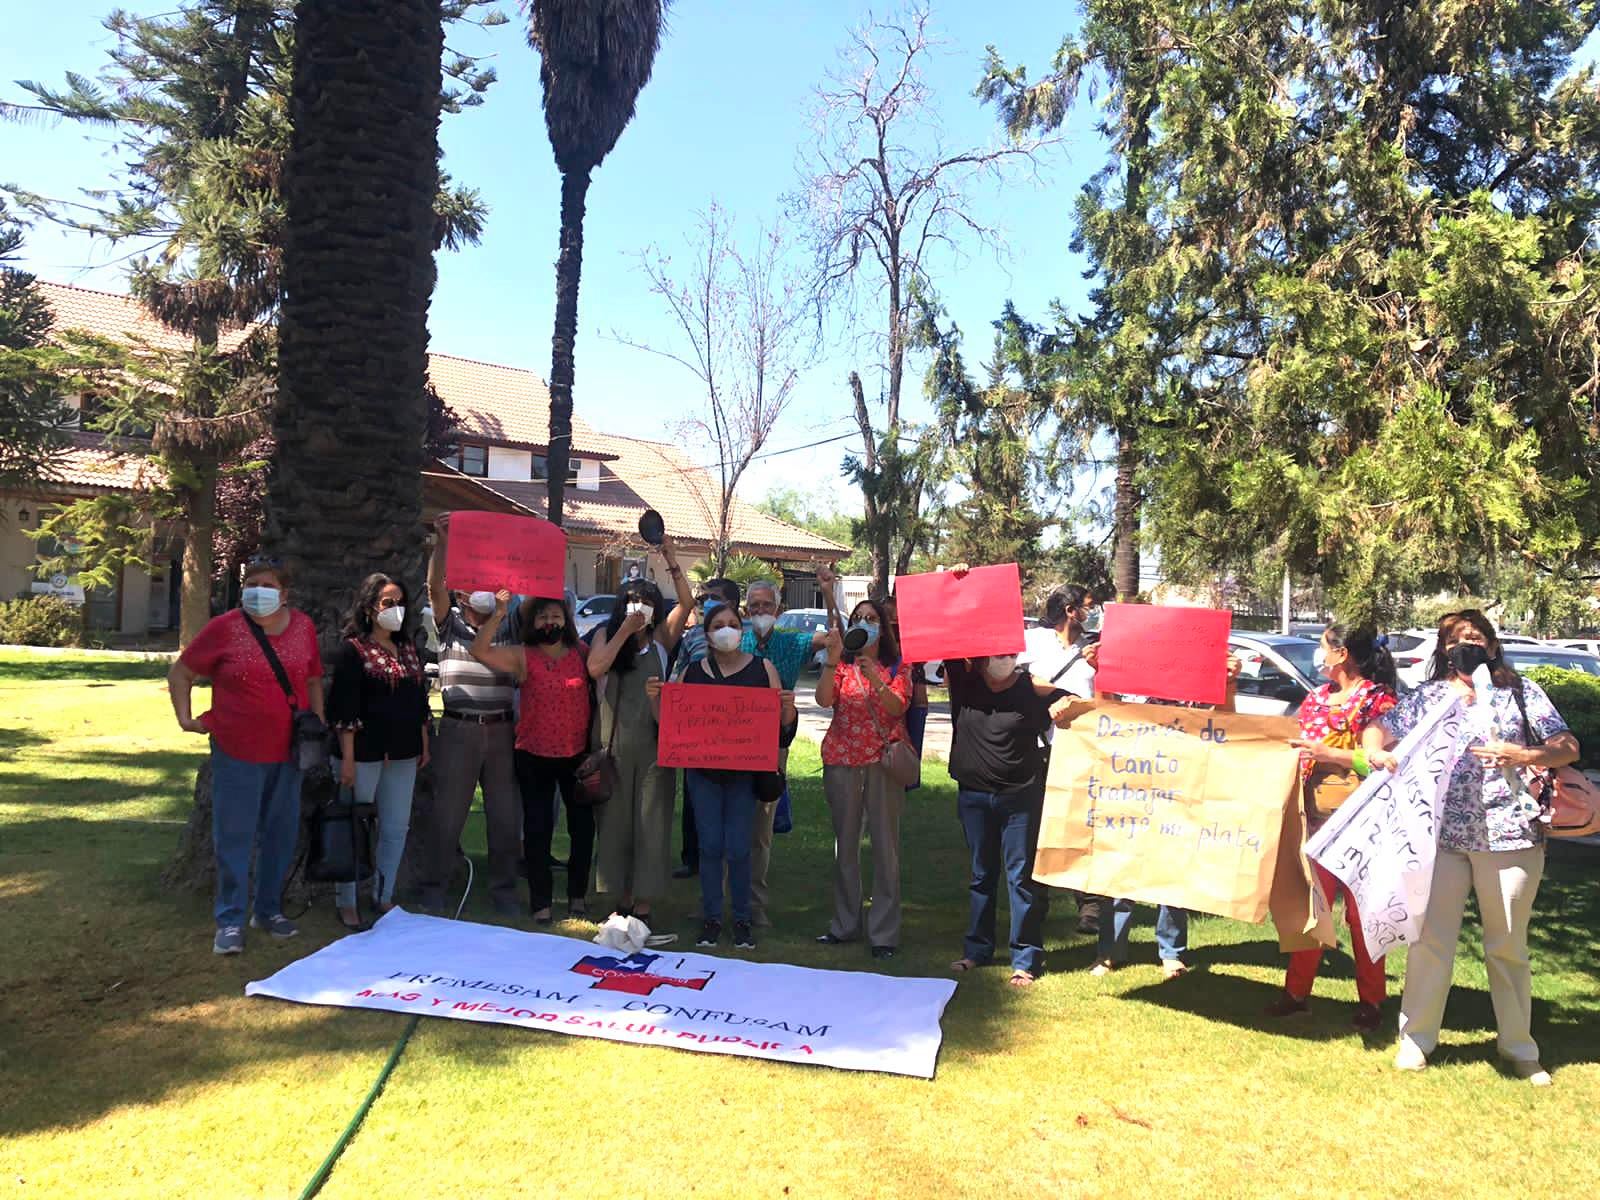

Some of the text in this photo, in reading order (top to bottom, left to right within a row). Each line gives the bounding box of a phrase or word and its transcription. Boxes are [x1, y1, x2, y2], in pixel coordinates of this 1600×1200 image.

[670, 687, 694, 713] Por
[1199, 718, 1229, 744] de
[1111, 750, 1180, 775] tanto
[1196, 820, 1261, 854] plata
[430, 997, 448, 1007] Y
[452, 1001, 559, 1022] MEJOR
[622, 999, 834, 1038] CONFUSAM
